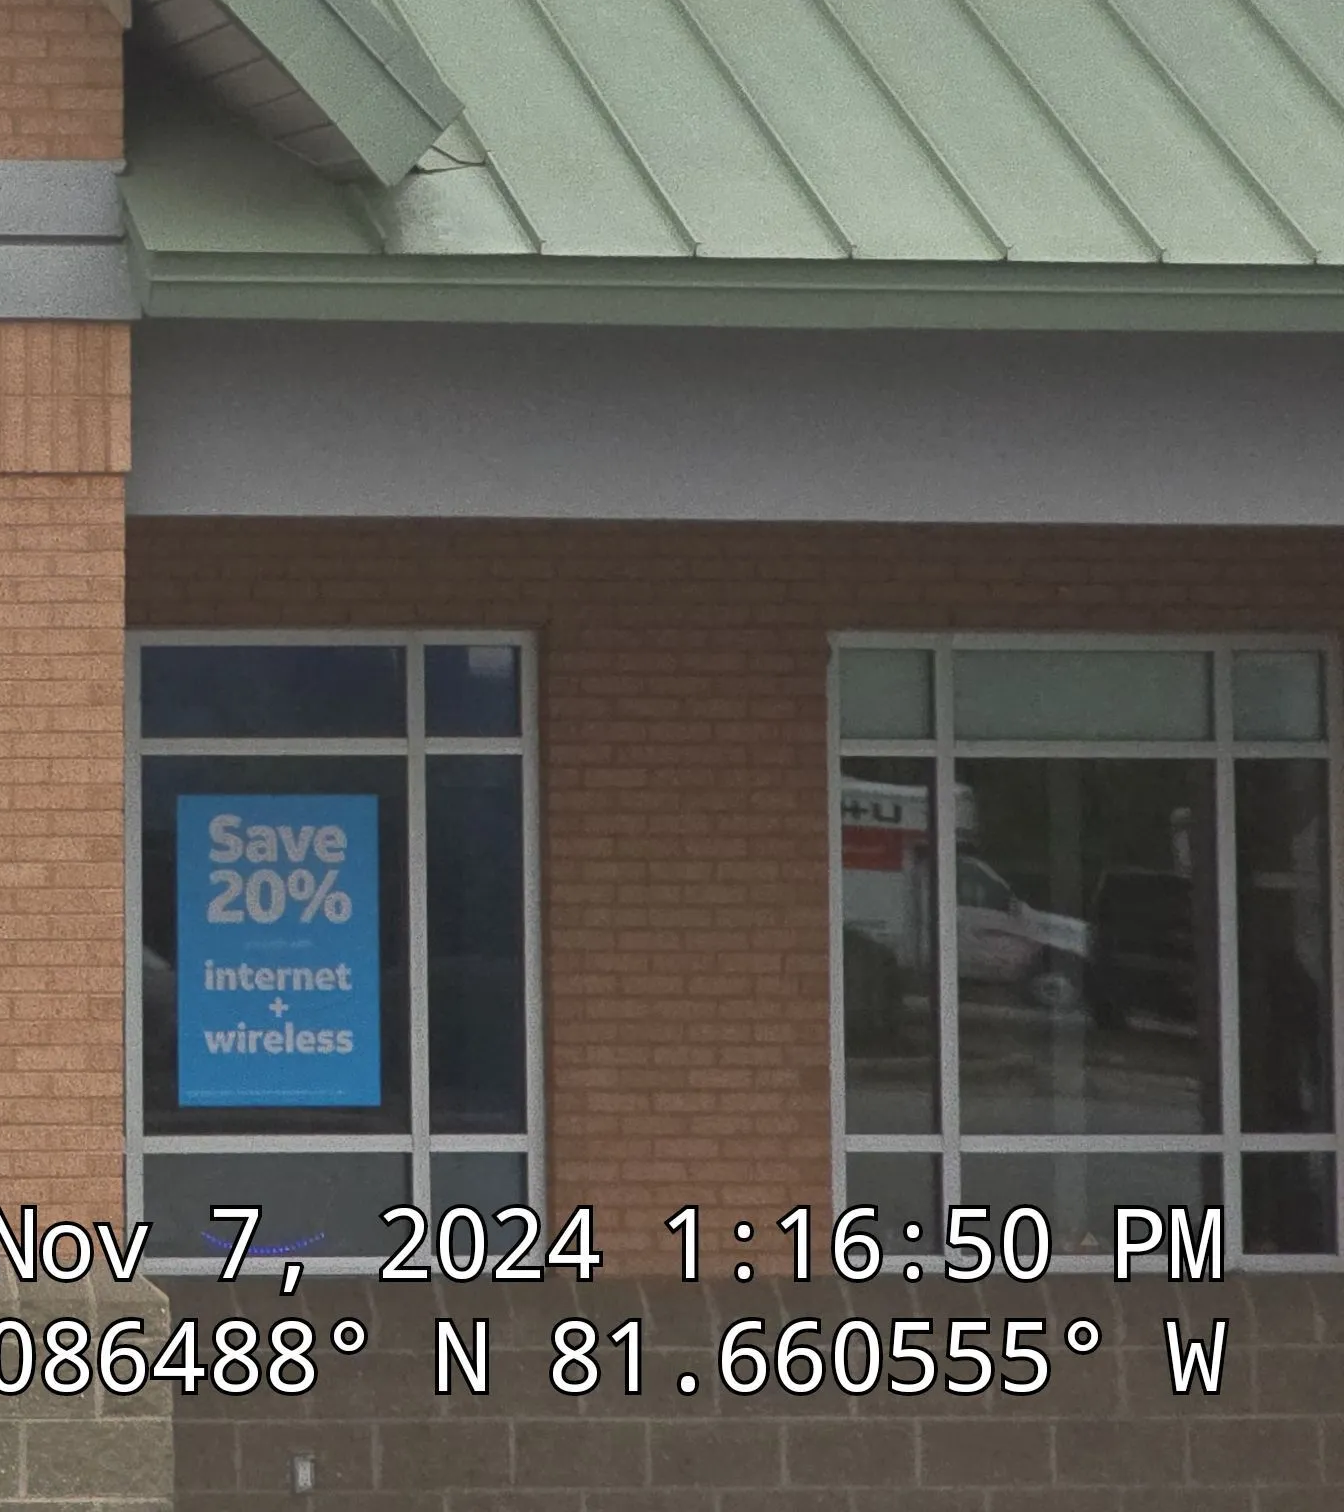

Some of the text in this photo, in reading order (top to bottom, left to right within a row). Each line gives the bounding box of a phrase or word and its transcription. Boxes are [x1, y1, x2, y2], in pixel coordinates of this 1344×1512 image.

[208, 813, 347, 864] Save
[206, 868, 353, 924] 20%
[204, 959, 353, 992] internet
[269, 996, 289, 1018] +
[203, 1021, 354, 1055] wireless
